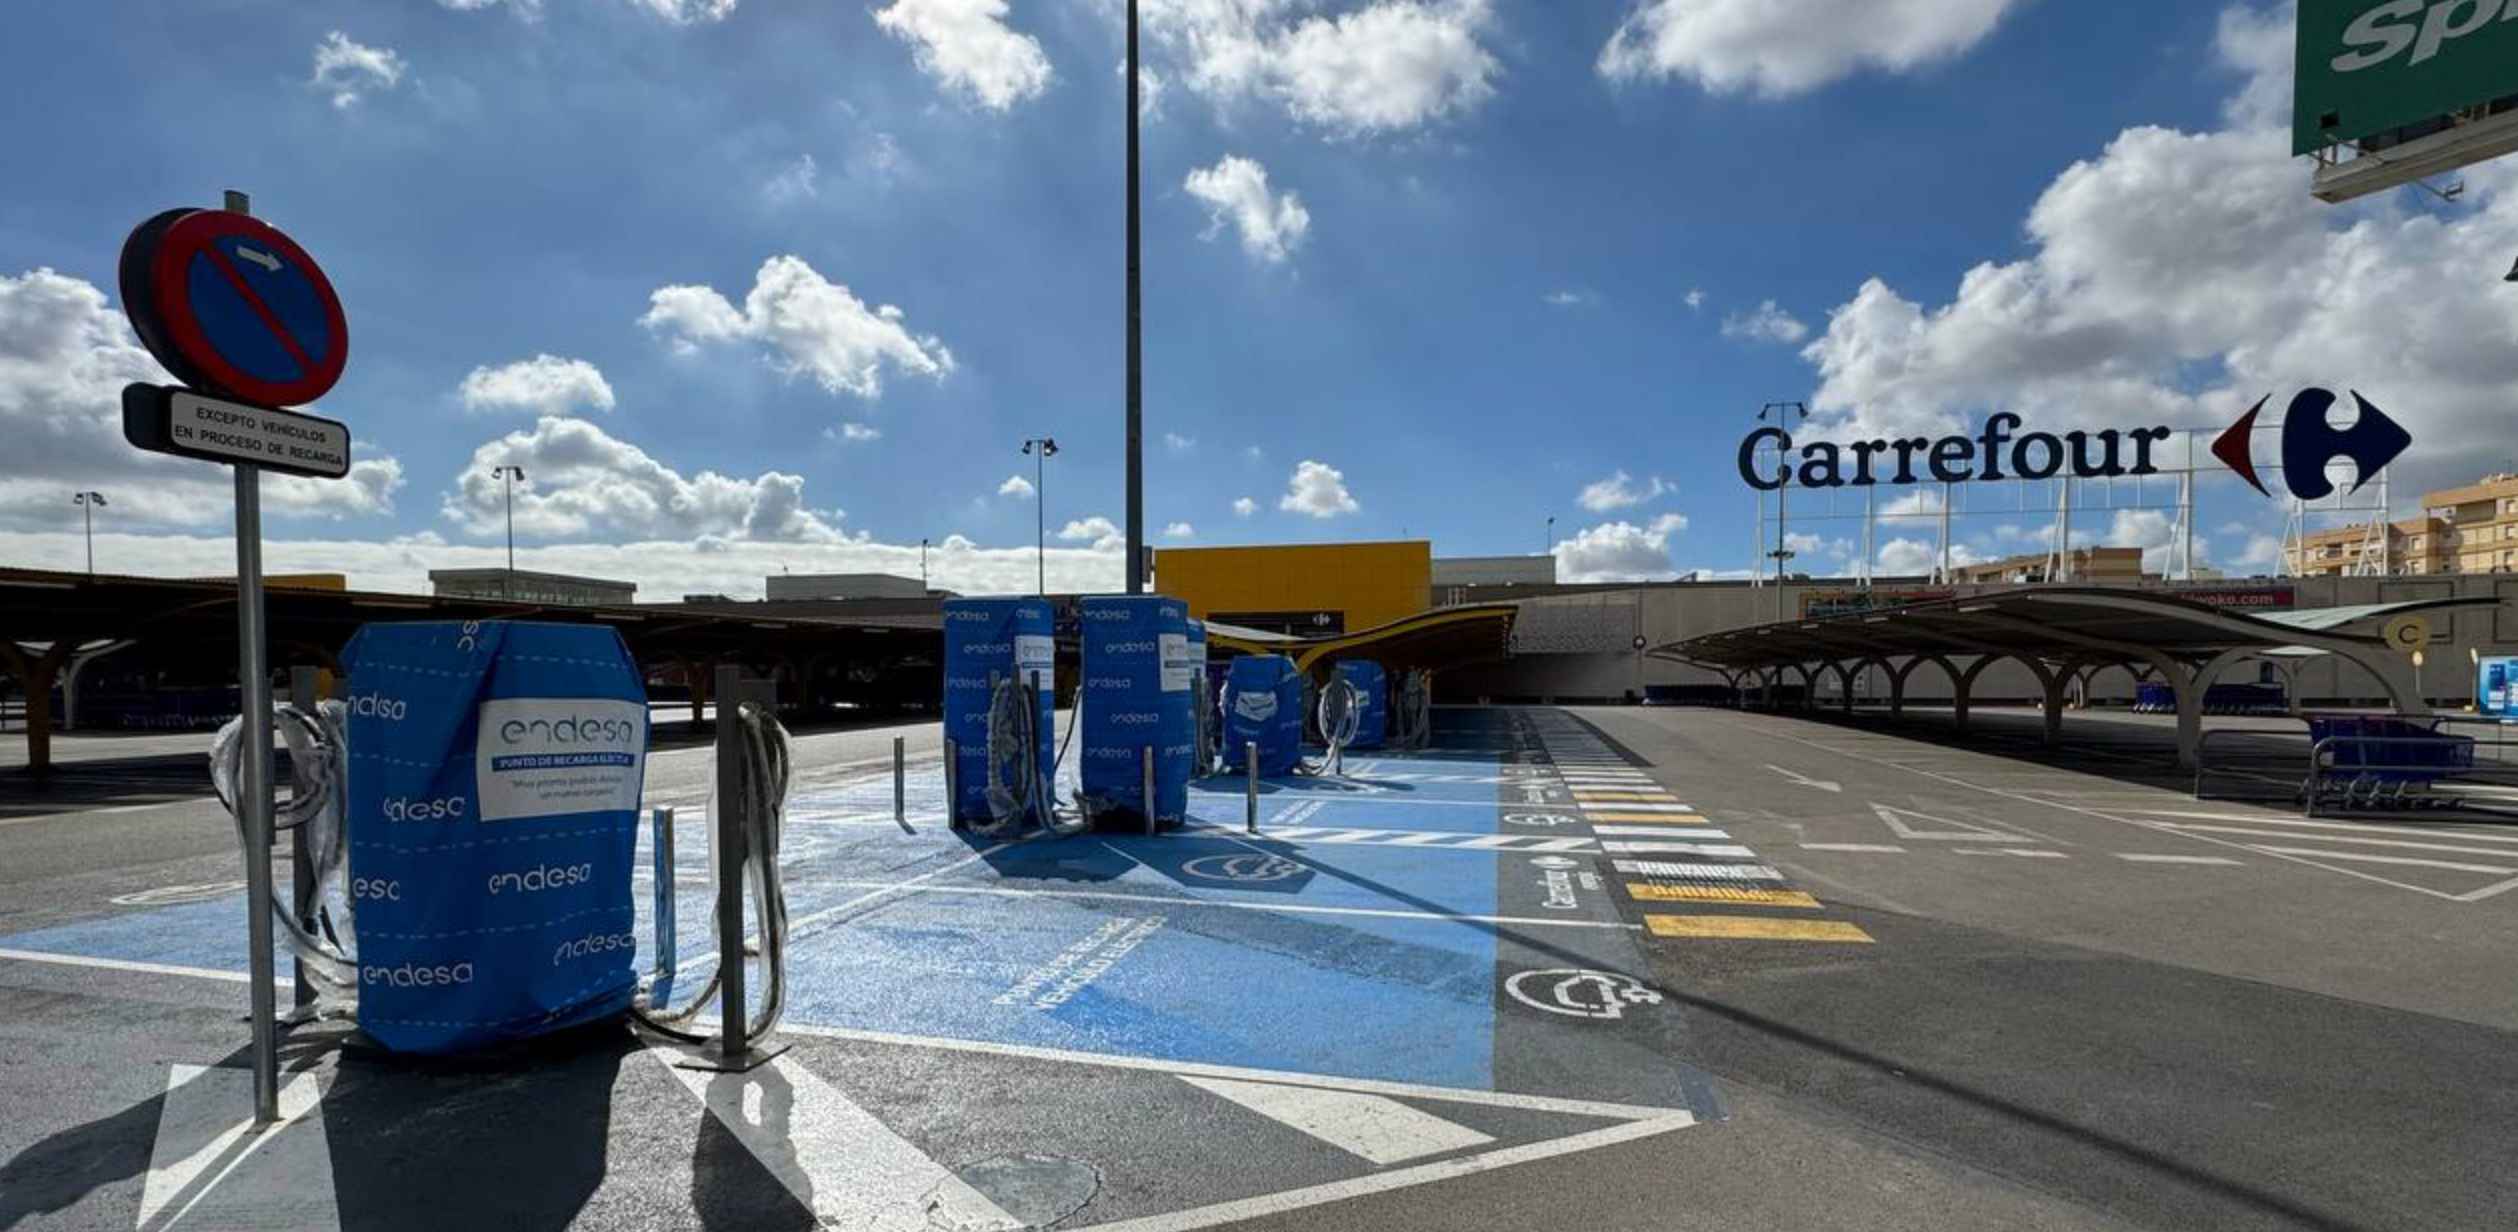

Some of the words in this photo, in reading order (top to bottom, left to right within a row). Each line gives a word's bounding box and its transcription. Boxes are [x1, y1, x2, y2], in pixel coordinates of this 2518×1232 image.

[196, 407, 256, 429] EXCEPTO
[175, 425, 193, 439] EN
[200, 429, 262, 450] PROCESO
[267, 440, 285, 455] DE
[289, 445, 344, 467] RECARGA
[1737, 411, 2171, 489] Carrefour
[2399, 625, 2420, 644] C
[502, 714, 634, 745] endesa
[489, 863, 592, 894] endesa
[363, 961, 473, 988] endesa
